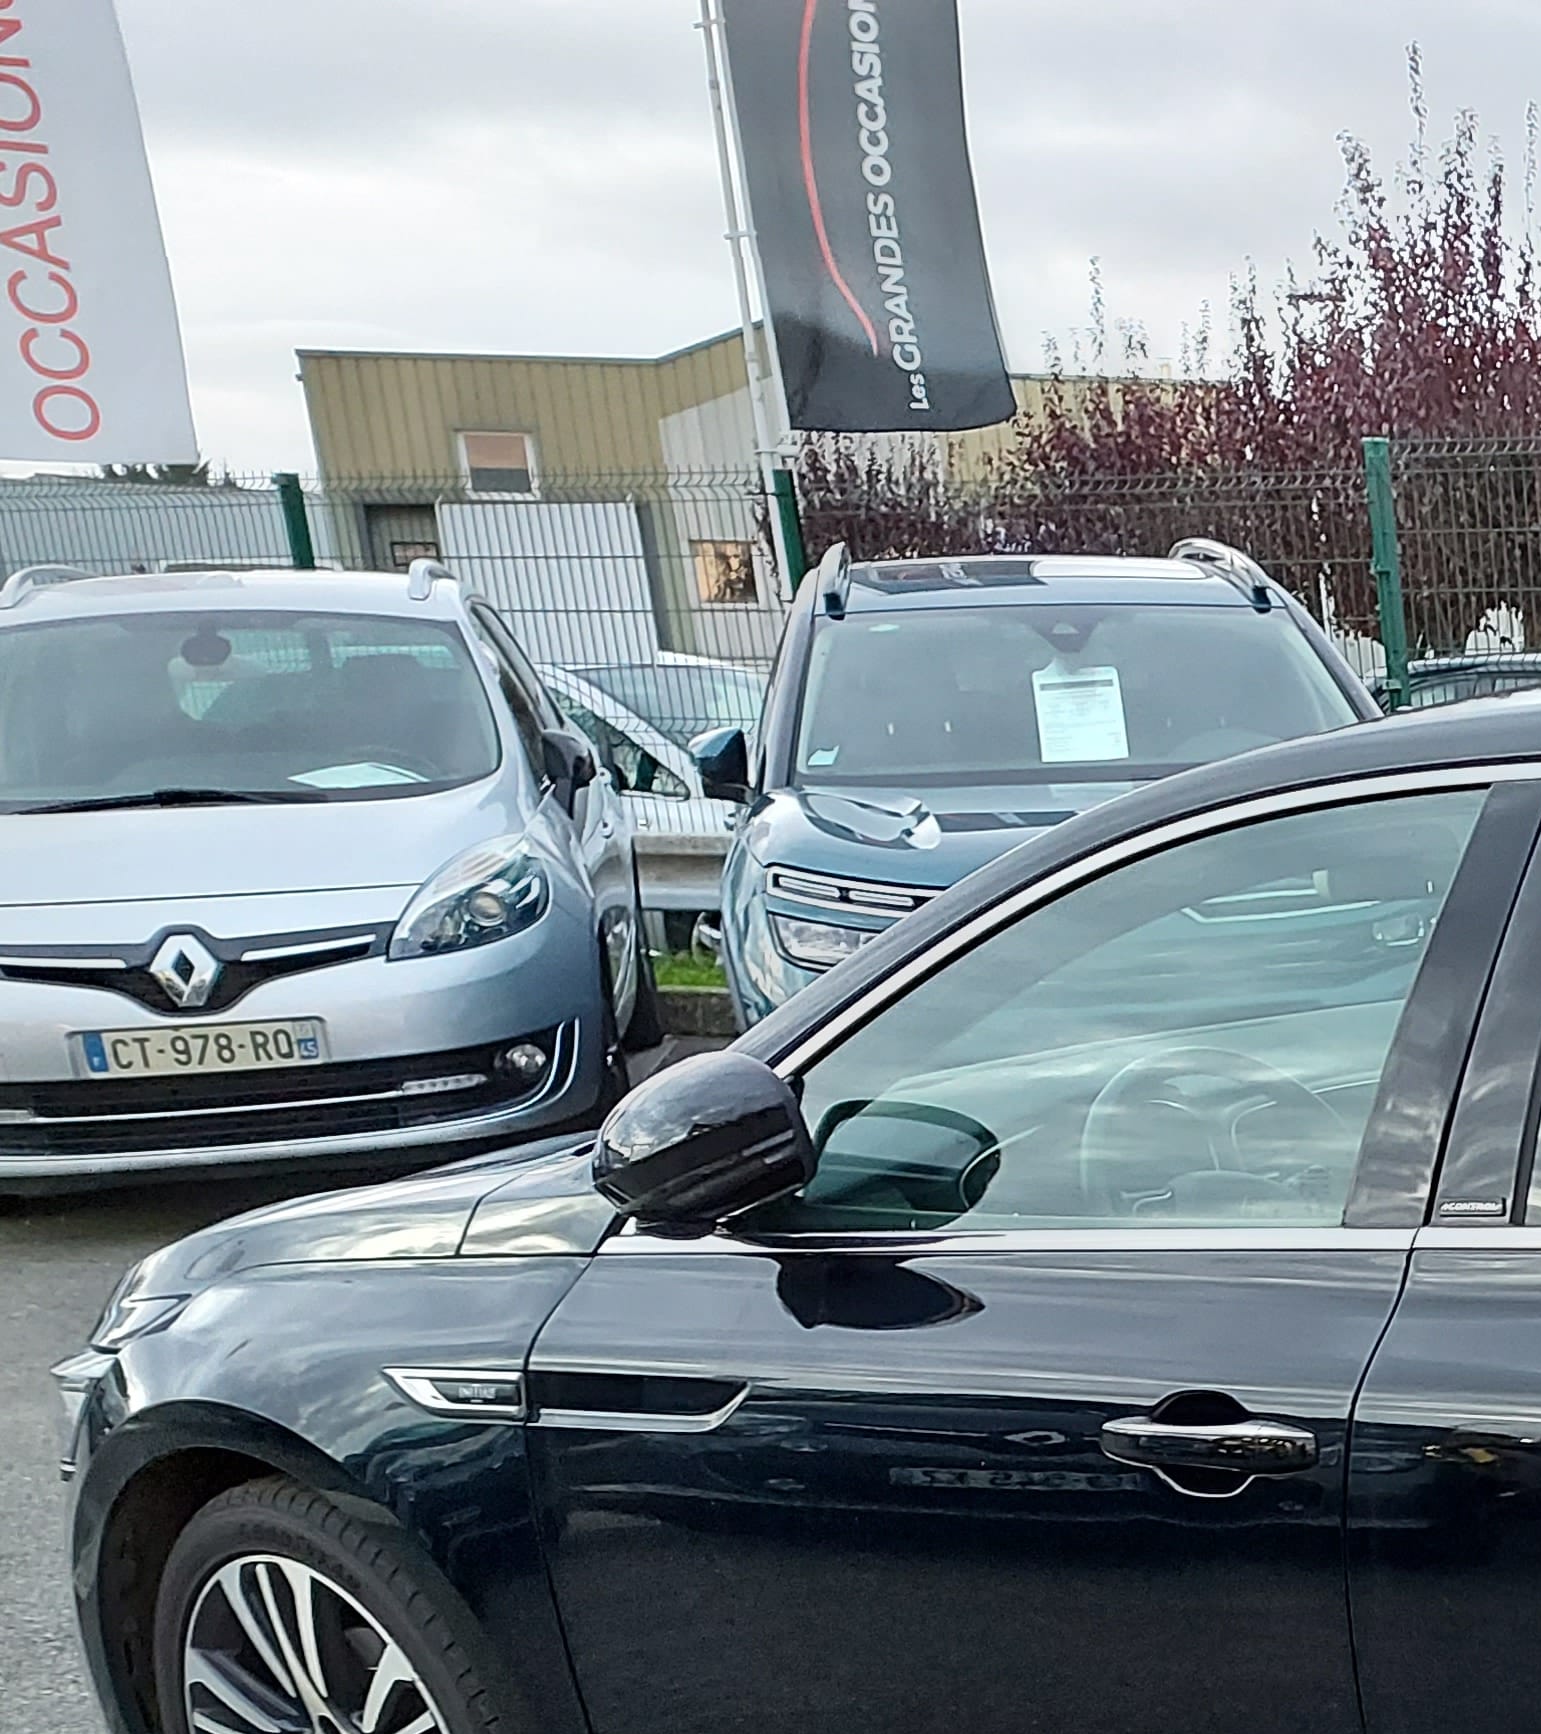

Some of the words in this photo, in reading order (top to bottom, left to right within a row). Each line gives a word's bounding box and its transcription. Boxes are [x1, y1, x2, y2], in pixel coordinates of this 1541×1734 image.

[0, 0, 100, 441] OCCASIO
[867, 192, 922, 371] GRANDES
[908, 372, 930, 410] Les
